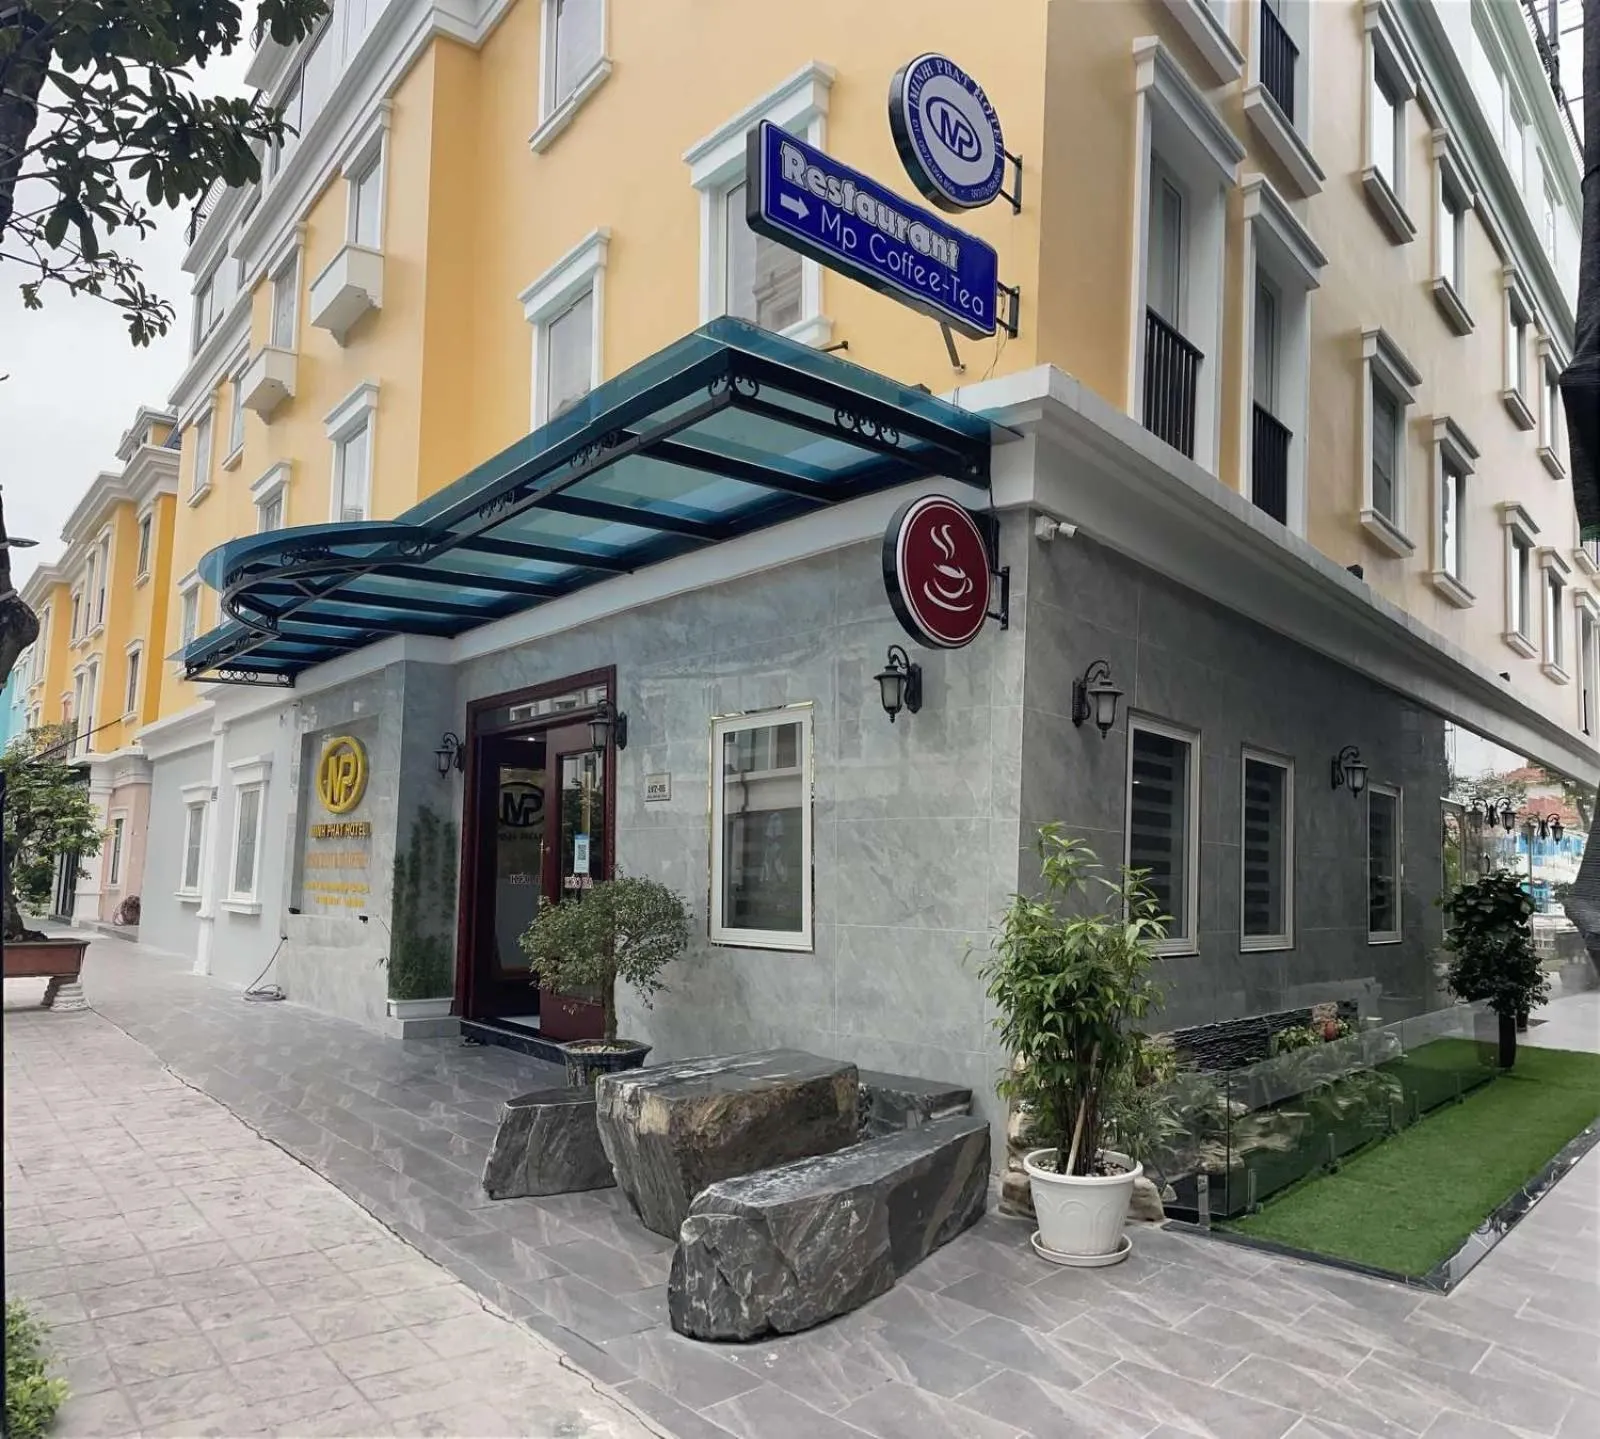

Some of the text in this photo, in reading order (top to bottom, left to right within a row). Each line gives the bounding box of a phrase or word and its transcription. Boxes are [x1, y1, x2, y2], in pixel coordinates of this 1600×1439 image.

[909, 63, 935, 107] MINH
[935, 60, 969, 86] PHAT
[780, 141, 960, 270] Restaurant
[820, 205, 985, 317] Mp Coffee-Tea
